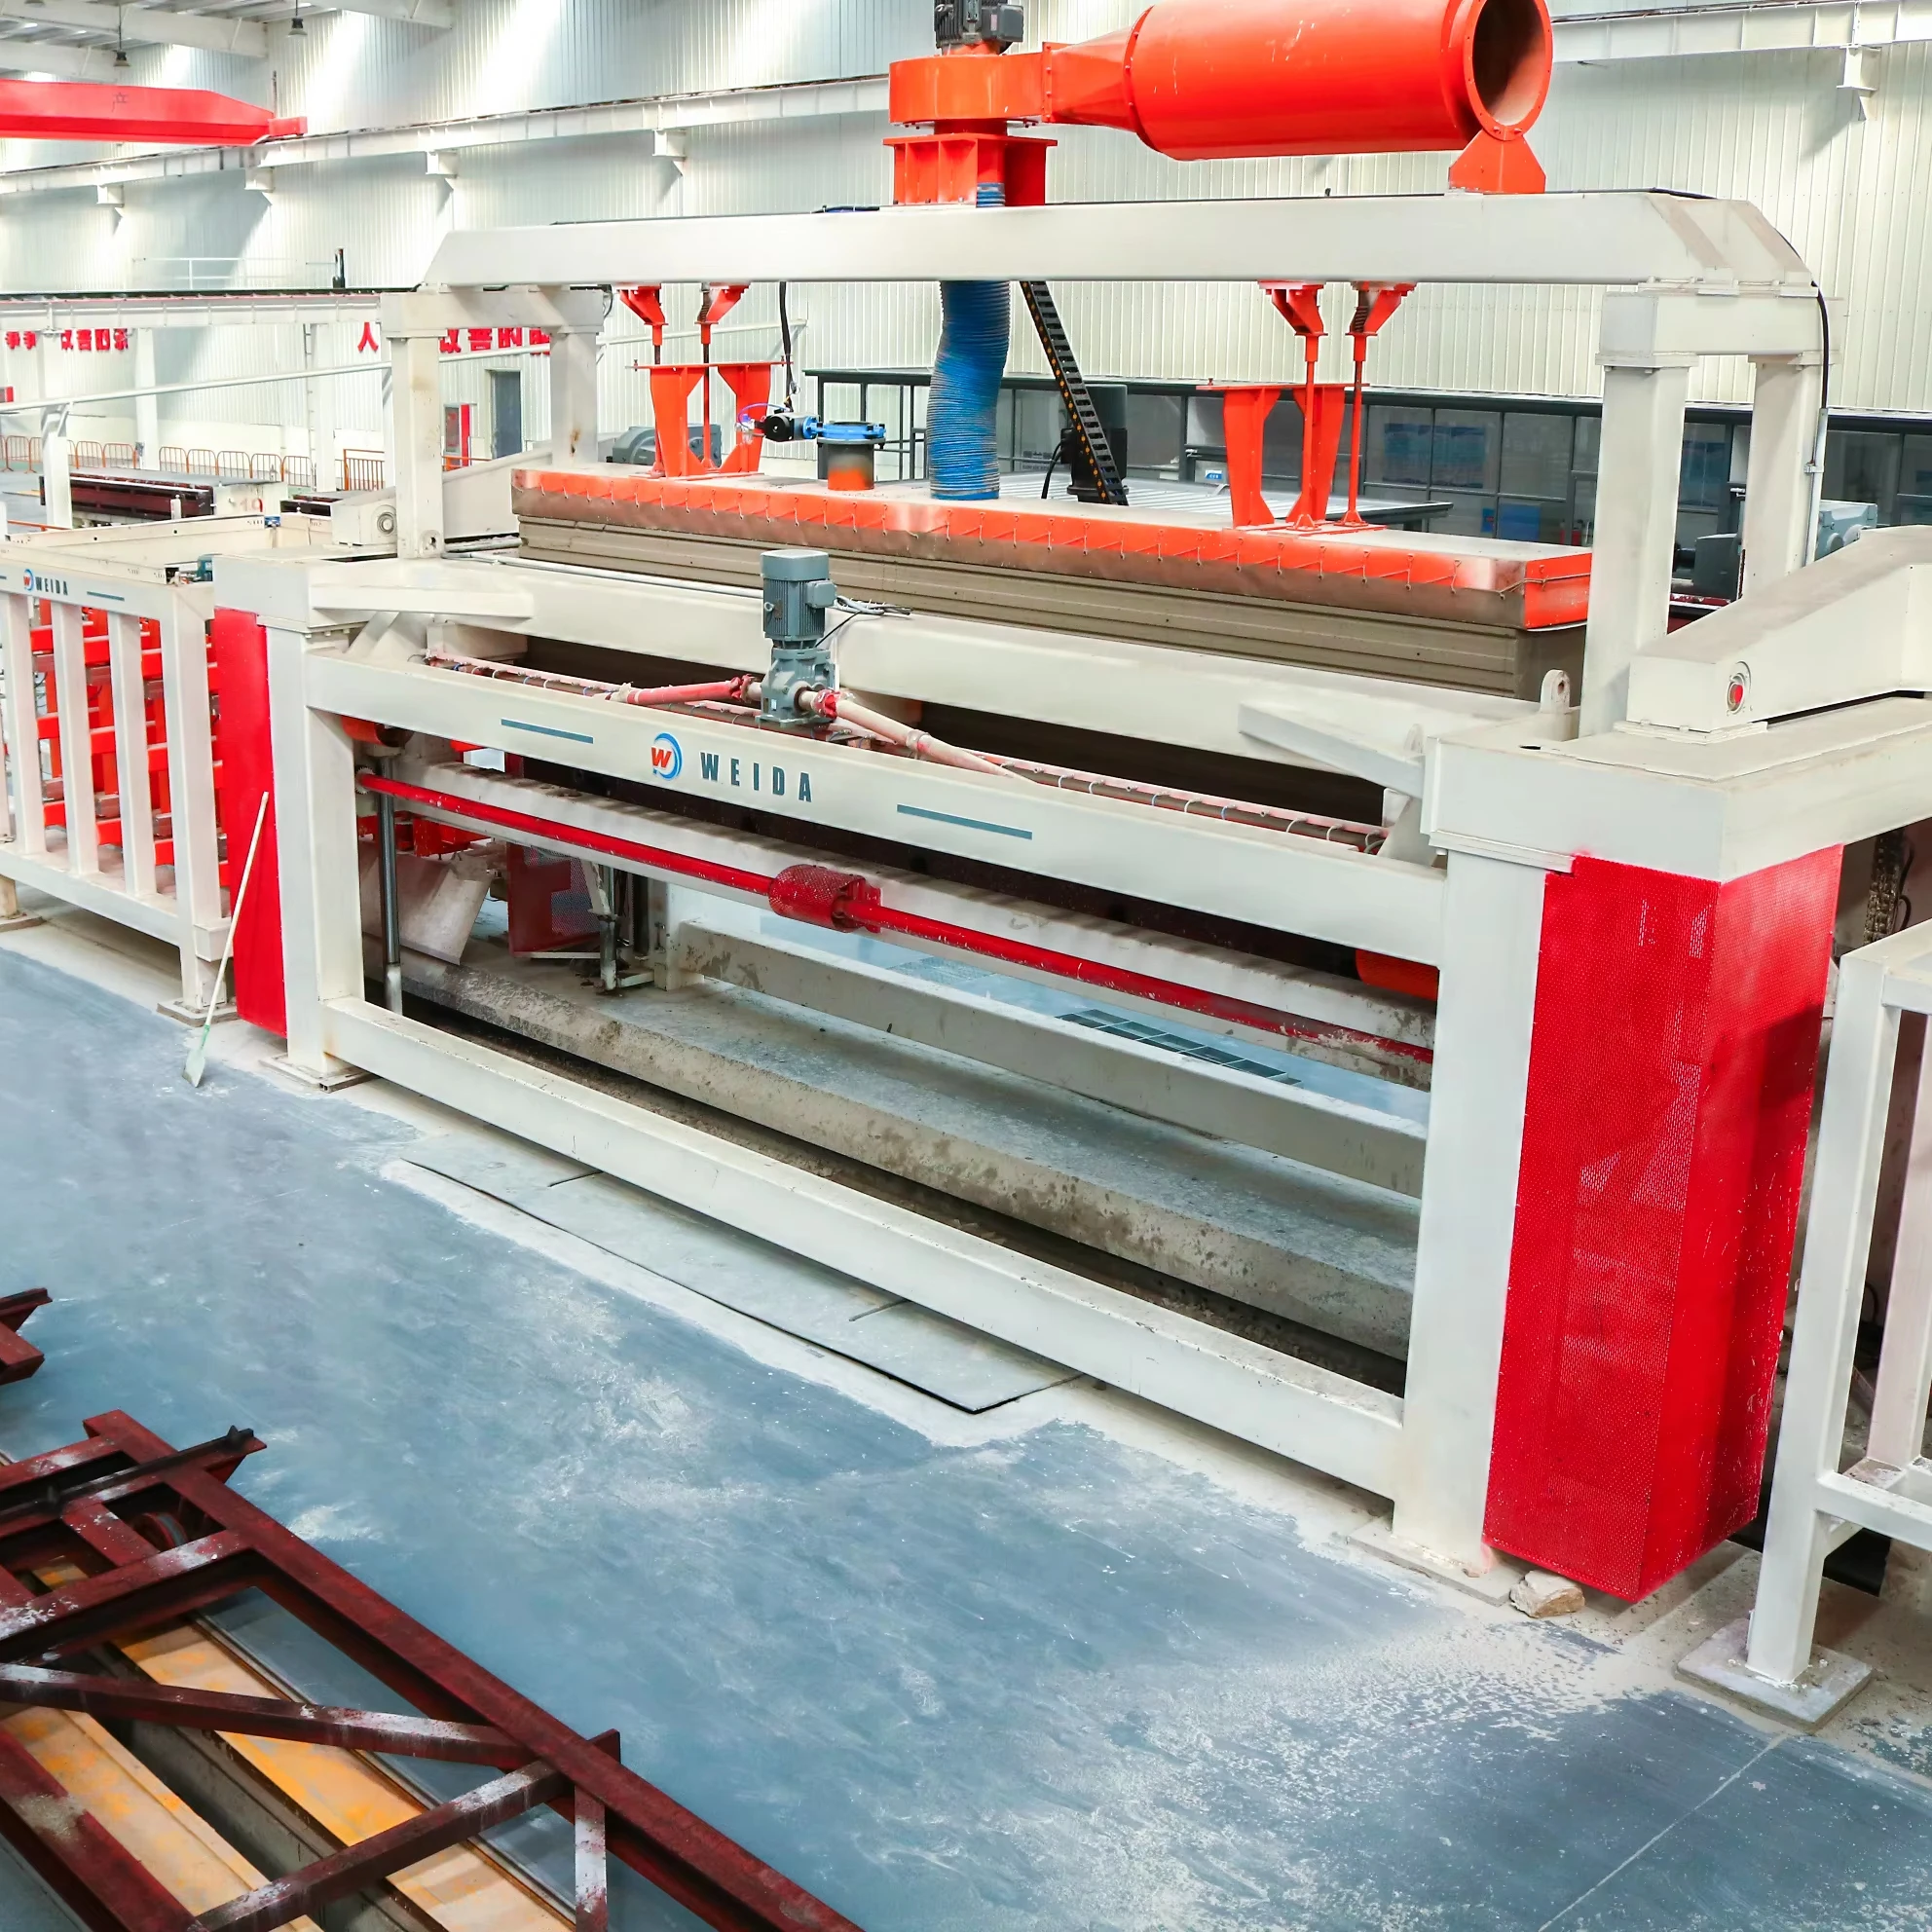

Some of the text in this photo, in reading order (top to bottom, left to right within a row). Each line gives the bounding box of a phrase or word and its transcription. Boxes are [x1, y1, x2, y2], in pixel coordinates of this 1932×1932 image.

[35, 576, 68, 595] WEIDA
[650, 746, 813, 802] W WEIDA
